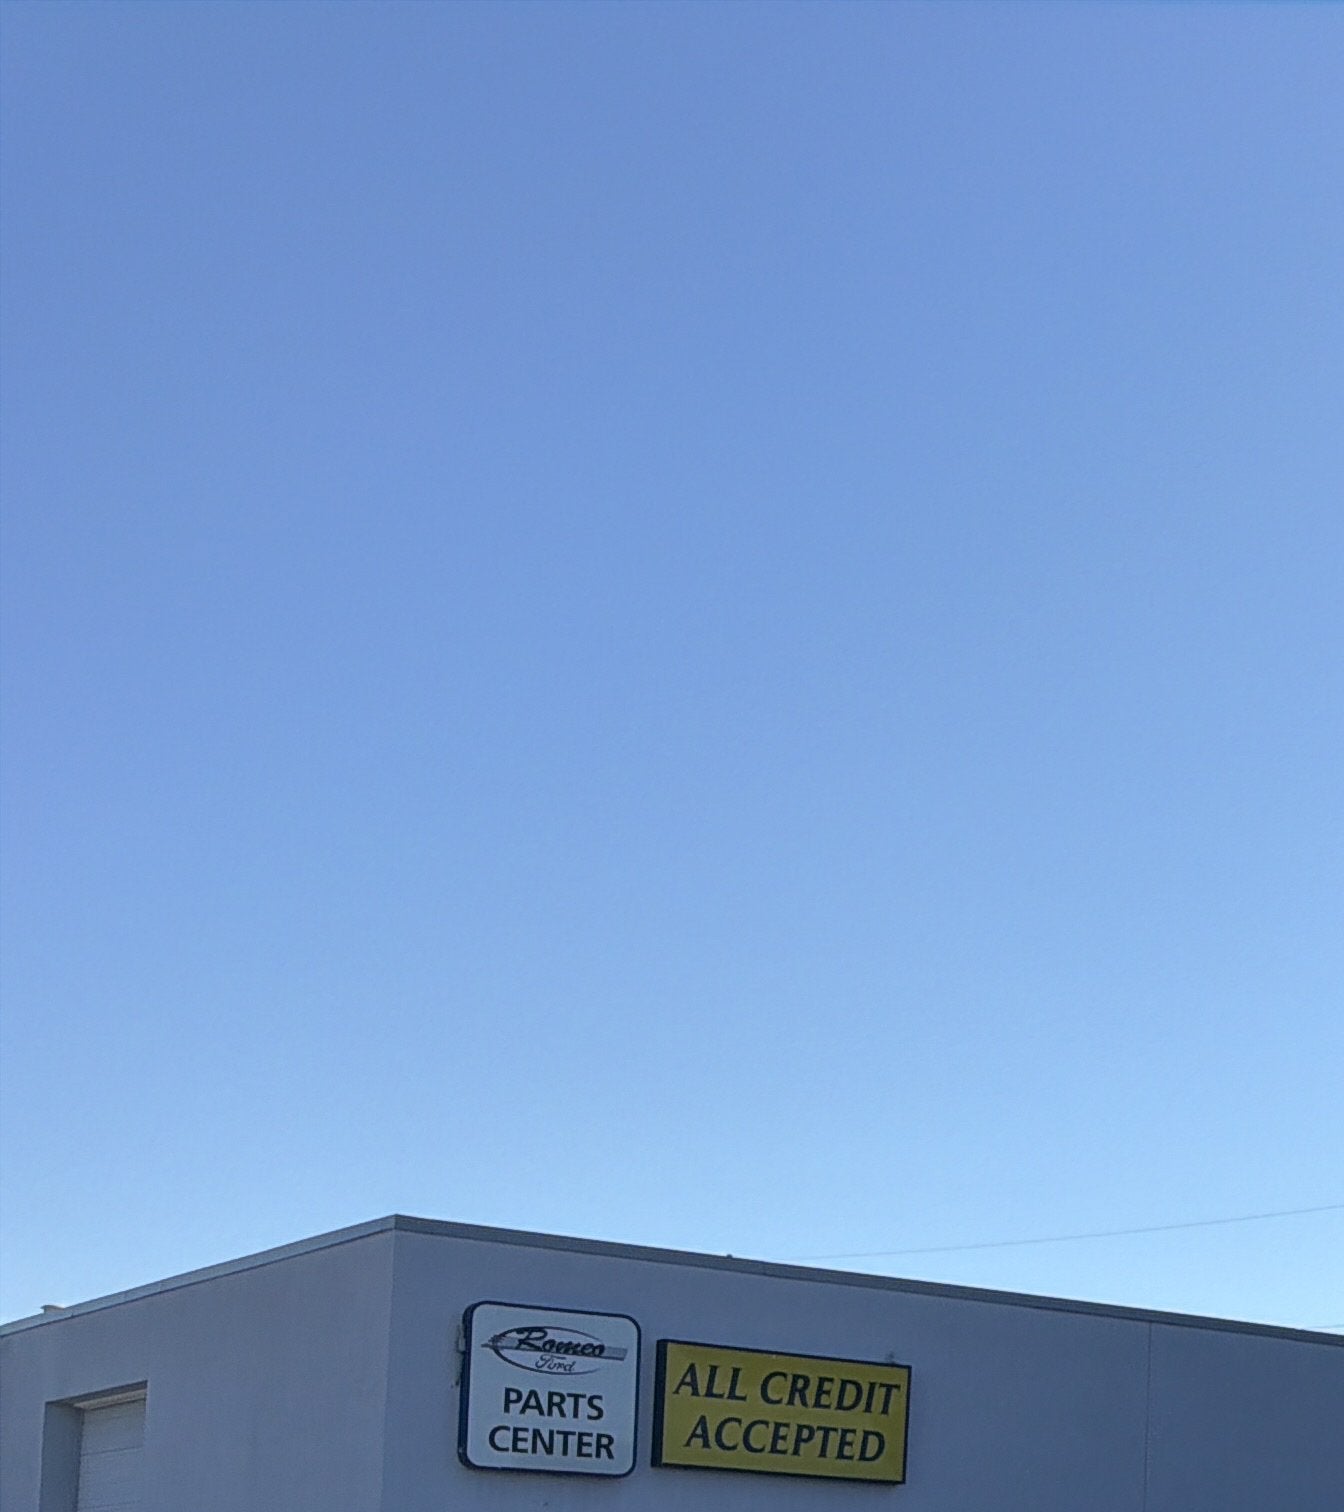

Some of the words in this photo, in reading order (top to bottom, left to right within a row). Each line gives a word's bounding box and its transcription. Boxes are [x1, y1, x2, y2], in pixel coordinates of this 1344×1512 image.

[510, 1326, 606, 1358] Romeo
[535, 1353, 577, 1373] Ford
[502, 1386, 604, 1421] PARTS
[672, 1362, 748, 1402] ALL
[760, 1370, 901, 1417] CREDIT
[488, 1425, 615, 1461] CENTER
[683, 1415, 886, 1463] ACCEPTED
